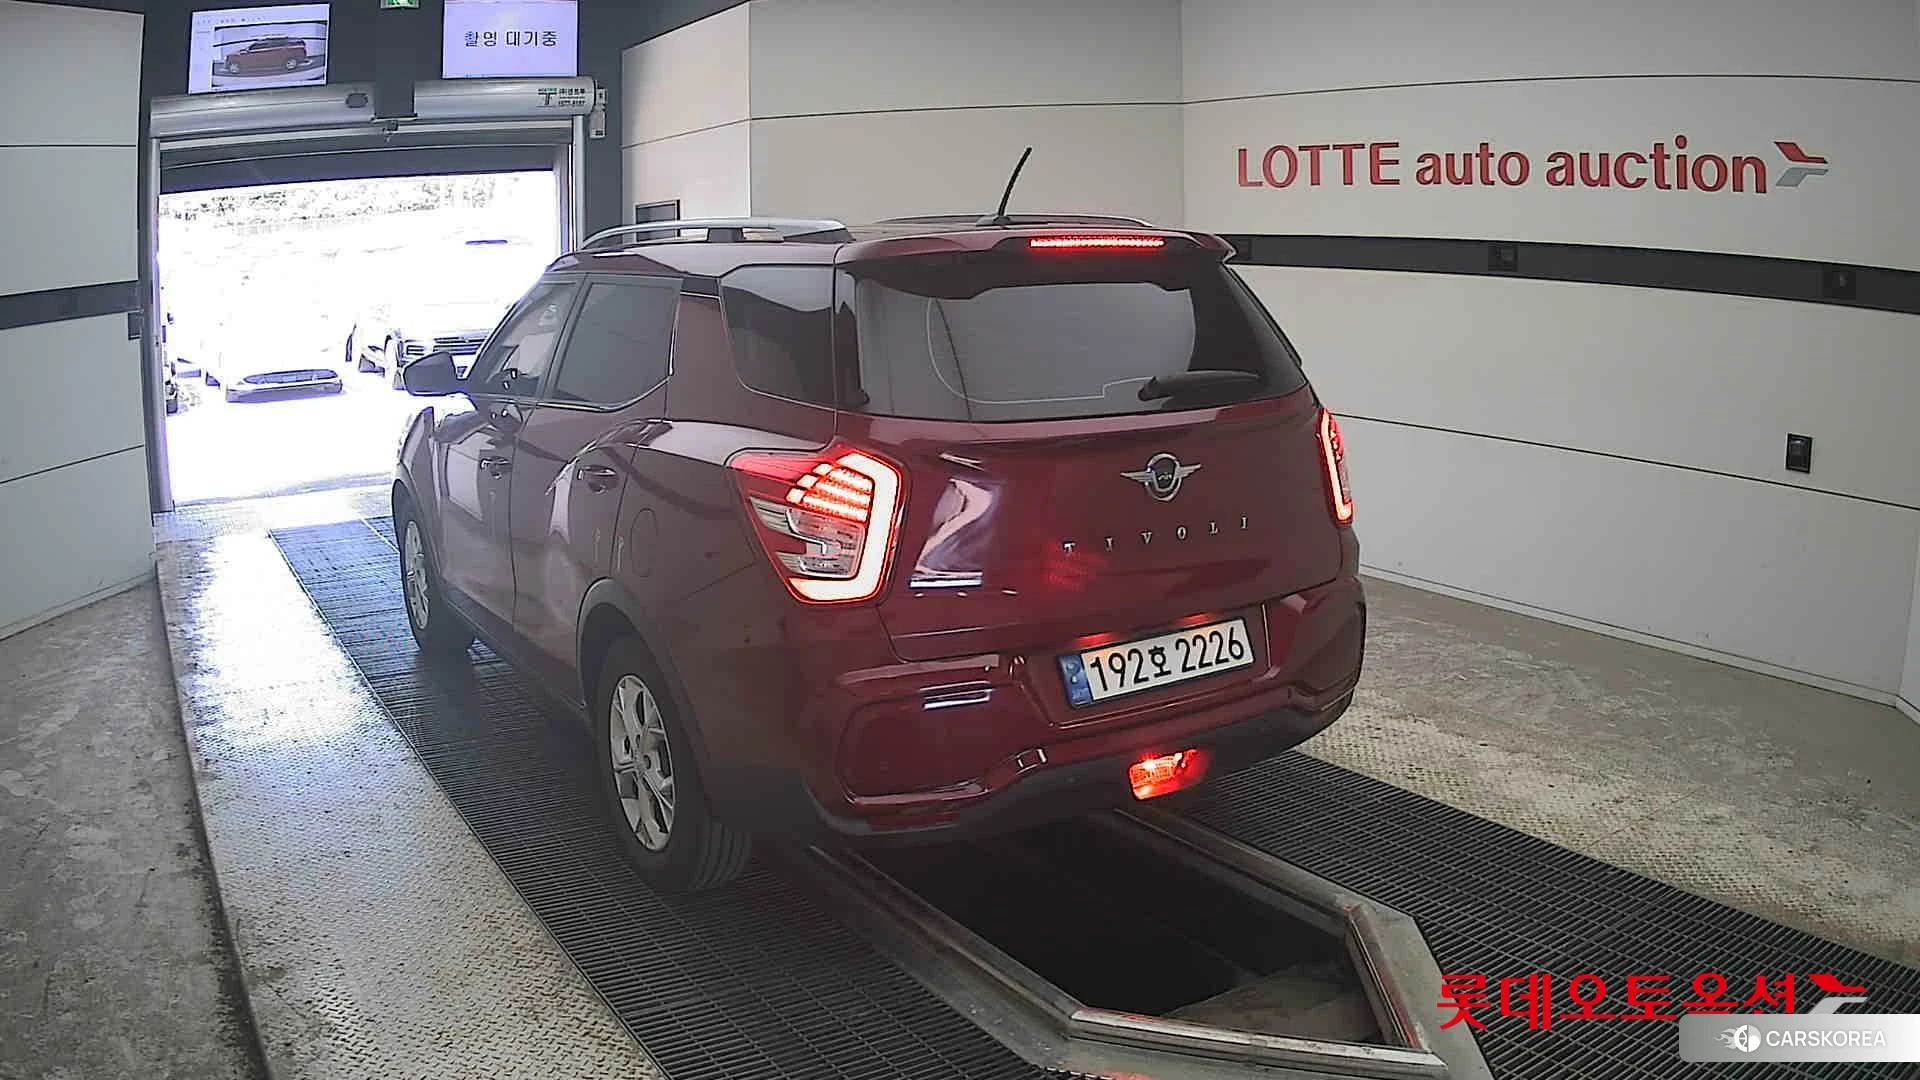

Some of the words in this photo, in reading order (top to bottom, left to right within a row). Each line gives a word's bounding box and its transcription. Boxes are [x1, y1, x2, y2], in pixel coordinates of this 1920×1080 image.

[506, 30, 557, 47] 대기중
[1238, 142, 1400, 188] LOTTE
[1415, 143, 1530, 186] auto
[1546, 135, 1767, 194] auction
[1063, 515, 1248, 555] TIVOLI
[1090, 645, 1171, 691] 192호
[1176, 627, 1244, 673] 2226
